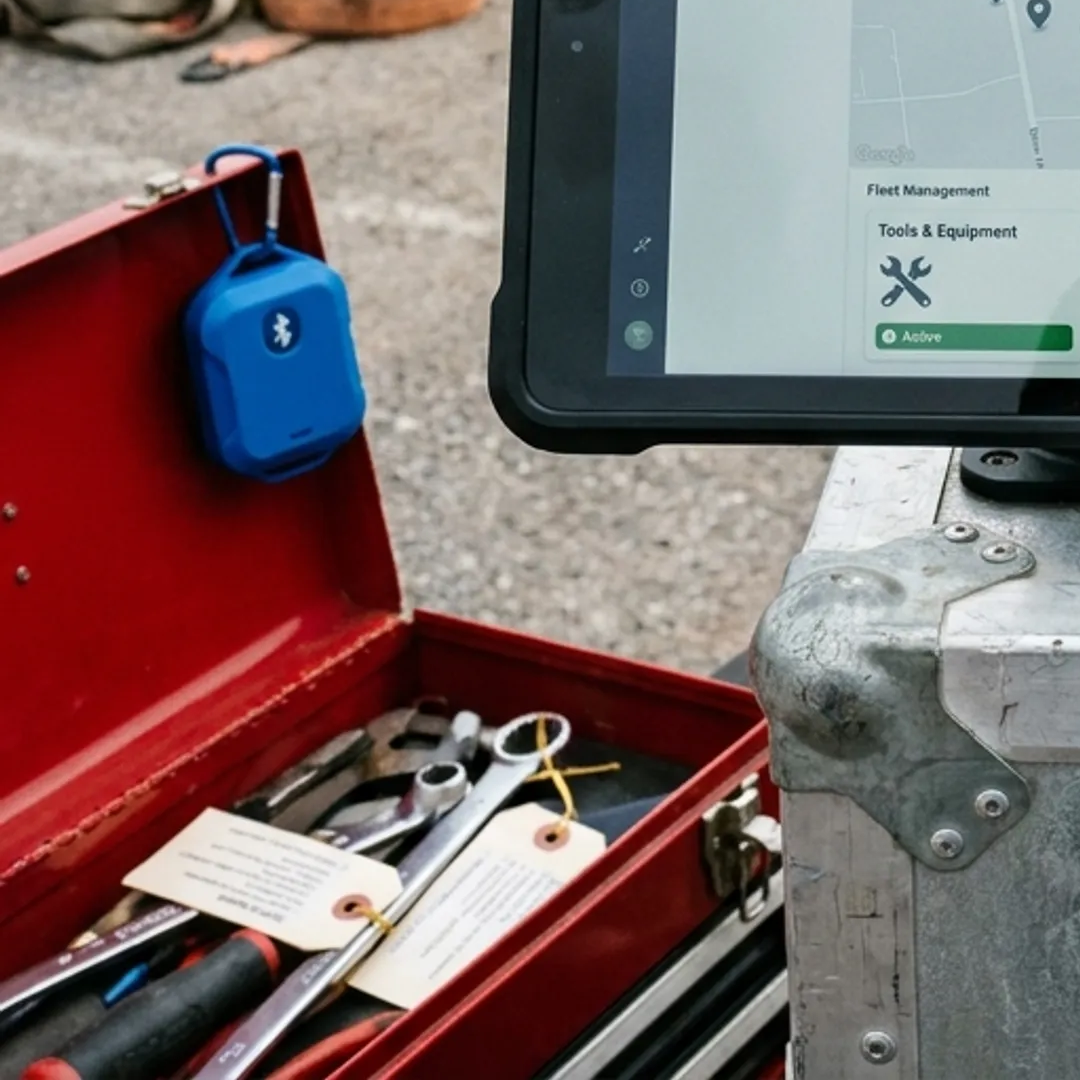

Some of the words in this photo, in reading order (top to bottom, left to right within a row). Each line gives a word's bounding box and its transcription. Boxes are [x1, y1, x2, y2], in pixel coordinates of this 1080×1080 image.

[866, 183, 901, 198] Fleet
[903, 184, 990, 200] Management
[878, 223, 918, 239] Tools
[922, 223, 933, 239] &
[936, 224, 1018, 241] Equipment
